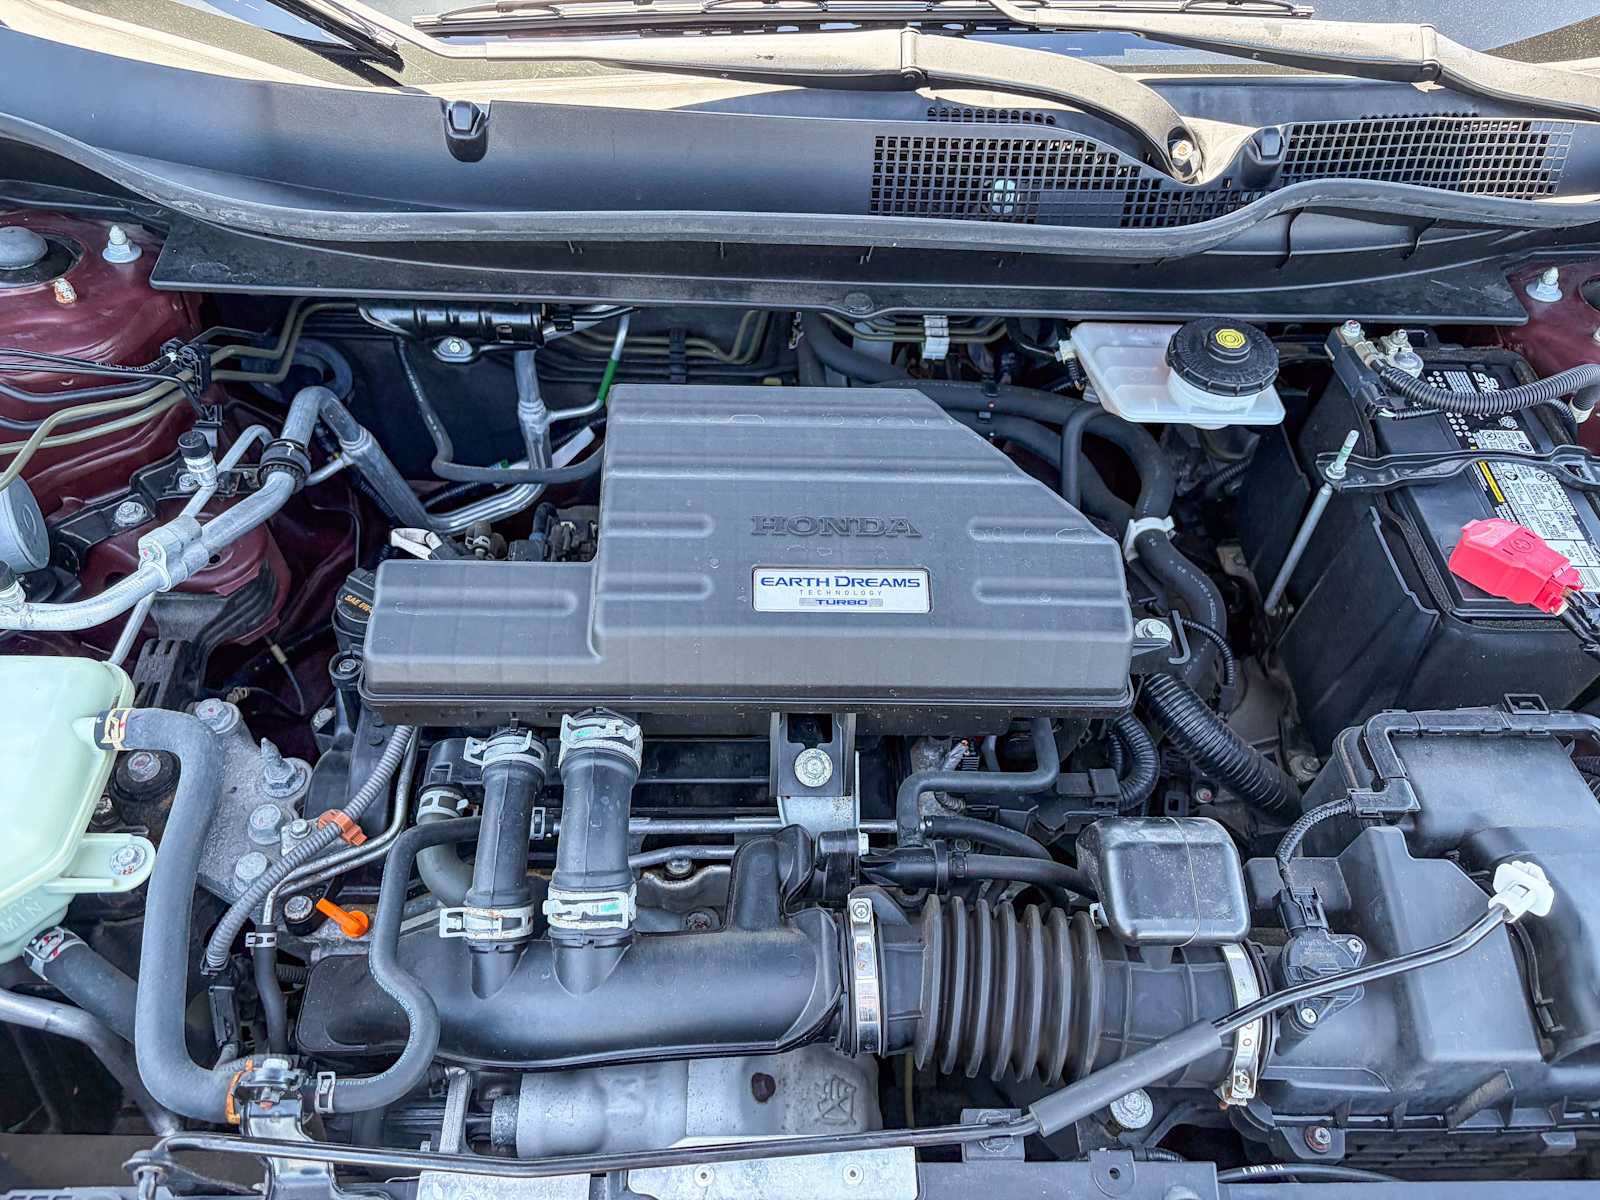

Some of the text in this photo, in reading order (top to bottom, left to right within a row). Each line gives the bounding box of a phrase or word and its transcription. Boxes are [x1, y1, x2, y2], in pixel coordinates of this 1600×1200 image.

[751, 515, 922, 537] HONDA
[760, 575, 920, 588] EARTH DREAMS
[800, 589, 882, 597] TECHNOLOGY
[344, 594, 362, 606] SAE
